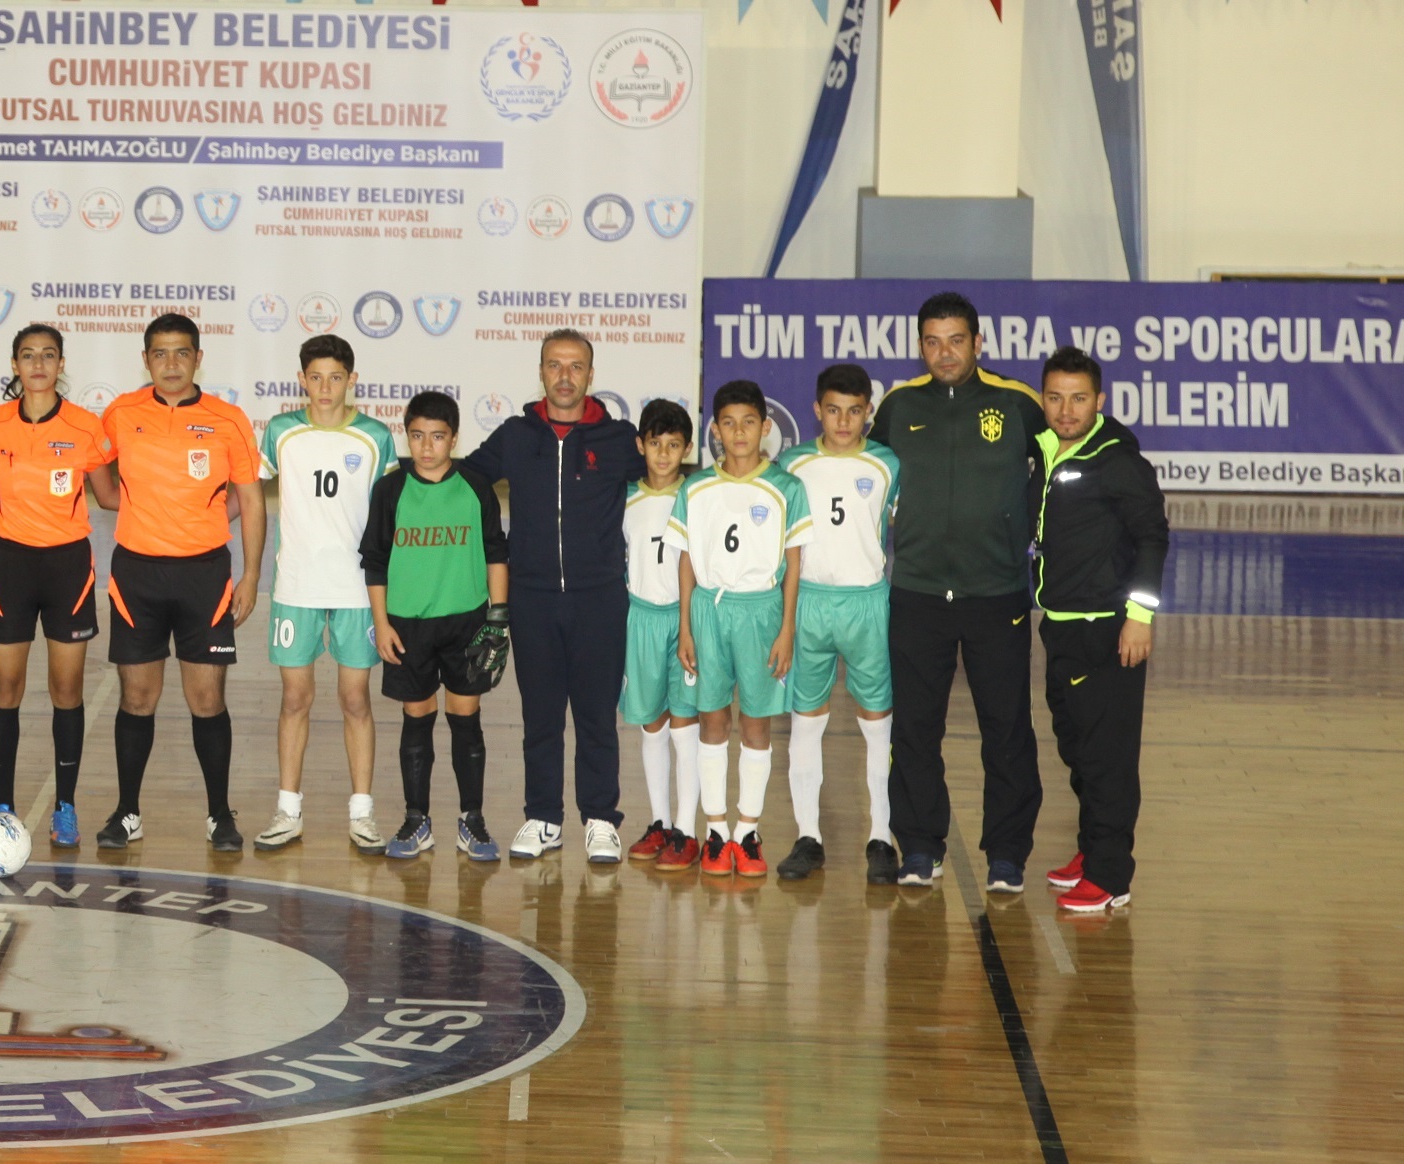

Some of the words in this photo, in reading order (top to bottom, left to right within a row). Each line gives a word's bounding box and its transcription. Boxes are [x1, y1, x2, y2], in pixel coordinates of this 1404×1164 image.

[260, 61, 371, 90] KUPASI
[87, 98, 264, 124] TURNUVASINA
[273, 102, 323, 130] HOŞ
[41, 137, 187, 158] TAHMAZOĞLU
[208, 141, 301, 162] Şahinbey
[306, 144, 395, 164] Belediye
[400, 145, 479, 165] Başkanı
[378, 208, 429, 222] KUPASI
[255, 224, 297, 236] FUTSAL
[301, 225, 380, 238] TURNUVASINA
[599, 313, 651, 327] KUPASI
[714, 304, 804, 359] TÜM
[1071, 326, 1121, 361] ve
[475, 329, 517, 341] FUTSAL
[1111, 371, 1289, 427] DİLERİM
[313, 469, 338, 498] 10
[1219, 461, 1323, 485] Belediye
[1331, 463, 1404, 486] Başka
[830, 496, 845, 526] 5
[393, 526, 471, 548] ORIENT
[651, 536, 665, 564] 7
[724, 523, 740, 553] 6
[273, 617, 295, 649] 10
